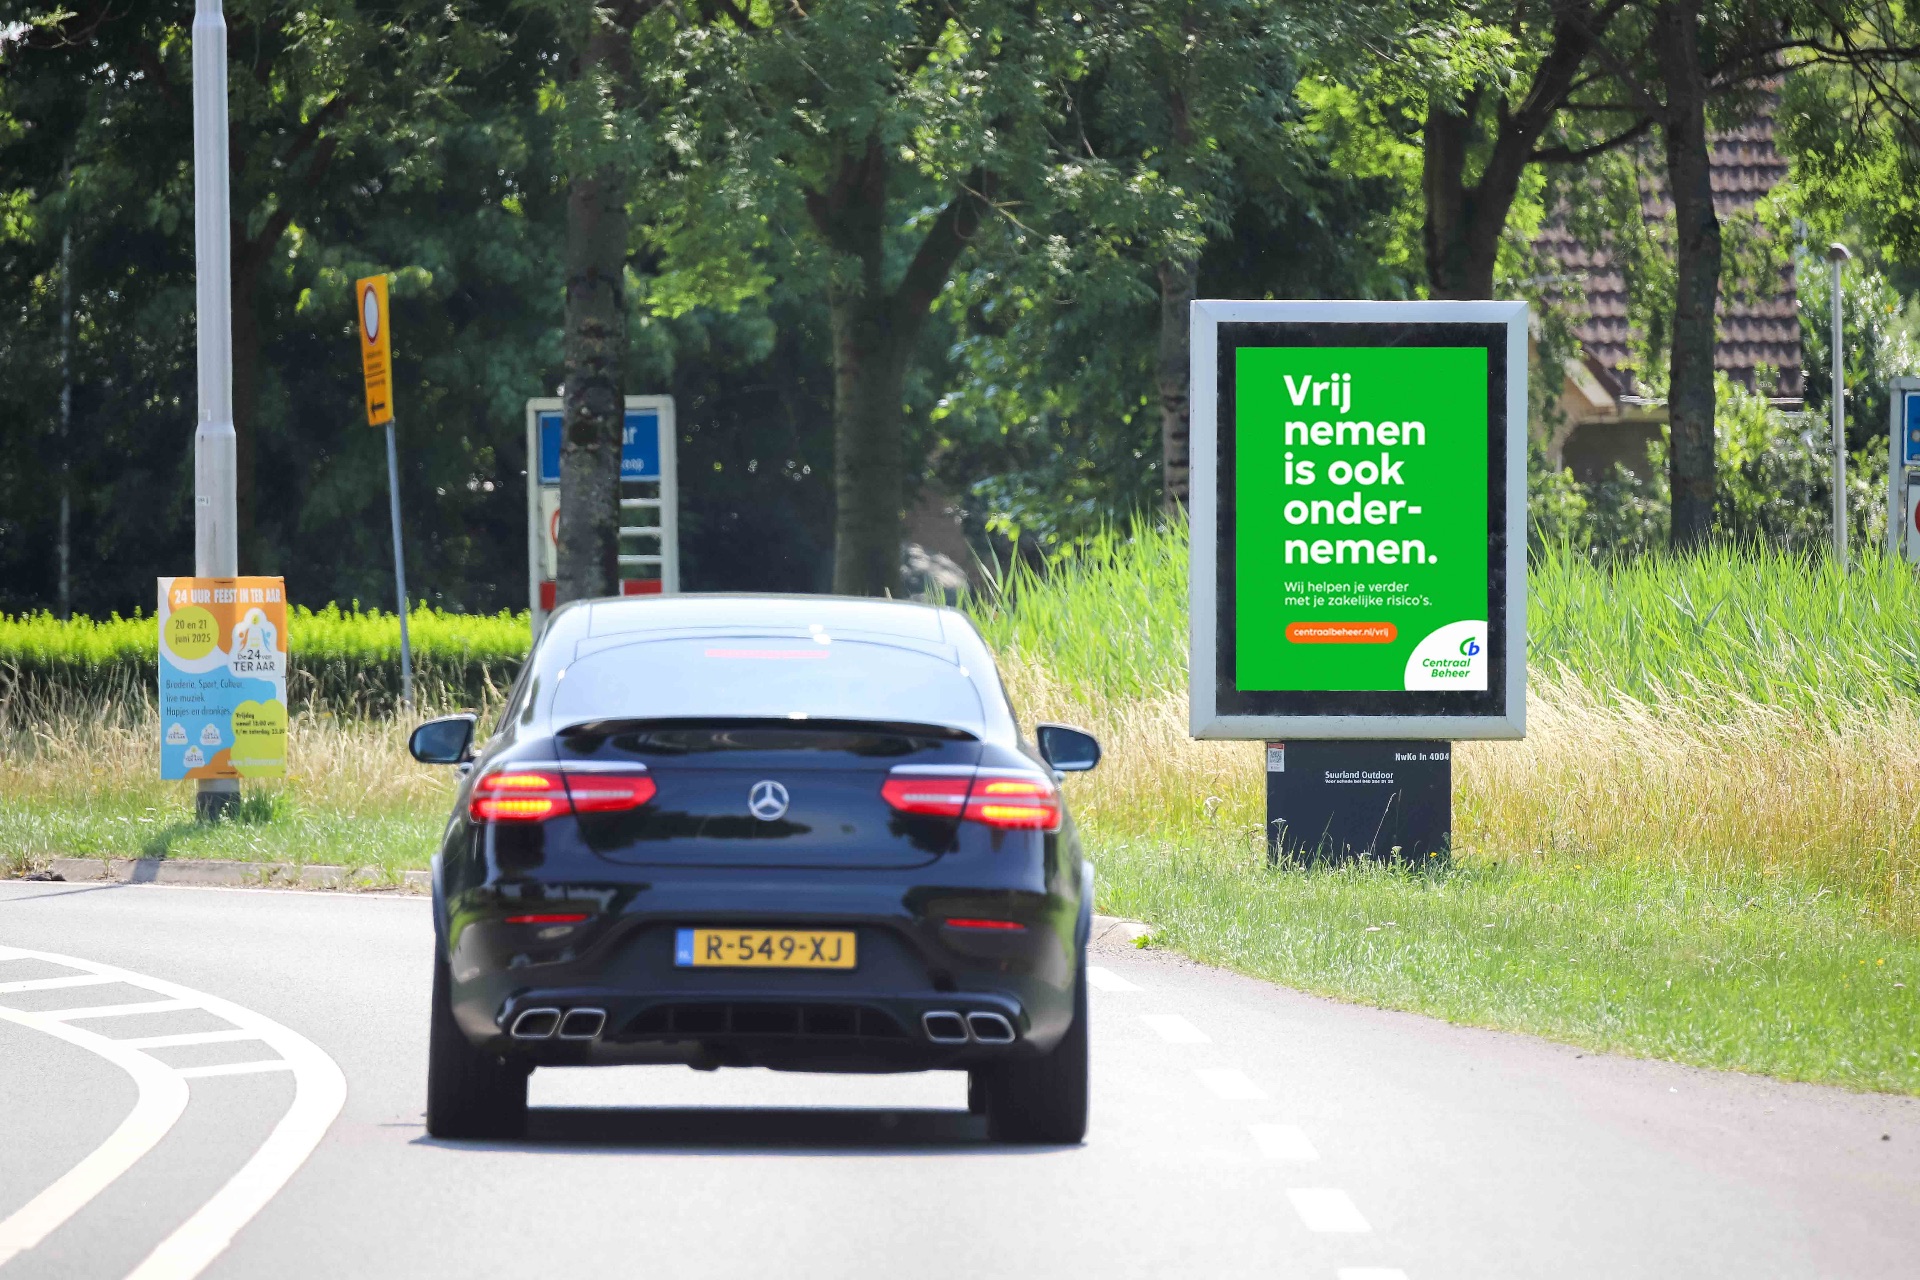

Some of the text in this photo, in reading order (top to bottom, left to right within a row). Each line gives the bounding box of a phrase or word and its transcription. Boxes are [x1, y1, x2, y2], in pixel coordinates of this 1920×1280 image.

[1283, 373, 1351, 414] Vrij
[1285, 421, 1425, 446] nemen
[1284, 452, 1405, 485] is ook
[1284, 492, 1422, 525] onder-
[1285, 539, 1438, 564] nemen.
[1284, 581, 1409, 594] Wij helpen je verder
[174, 588, 281, 604] 24 UUR FEEST IN TER AAR
[1284, 595, 1433, 608] met je zakelijke risico's.
[175, 619, 207, 630] 20 en 21
[1293, 628, 1389, 637] centraalbeheer.nl/vrij
[175, 633, 211, 645] juni 2025
[247, 649, 260, 660] 24
[233, 661, 276, 671] TER AAR
[1422, 658, 1471, 668] Centraal
[1431, 668, 1471, 678] Beheer
[166, 706, 189, 718] Hapjes
[191, 708, 200, 716] en
[1429, 752, 1450, 761] 4004
[1325, 770, 1394, 779] Suurland Outdoor
[706, 934, 842, 962] R-549-XJ
